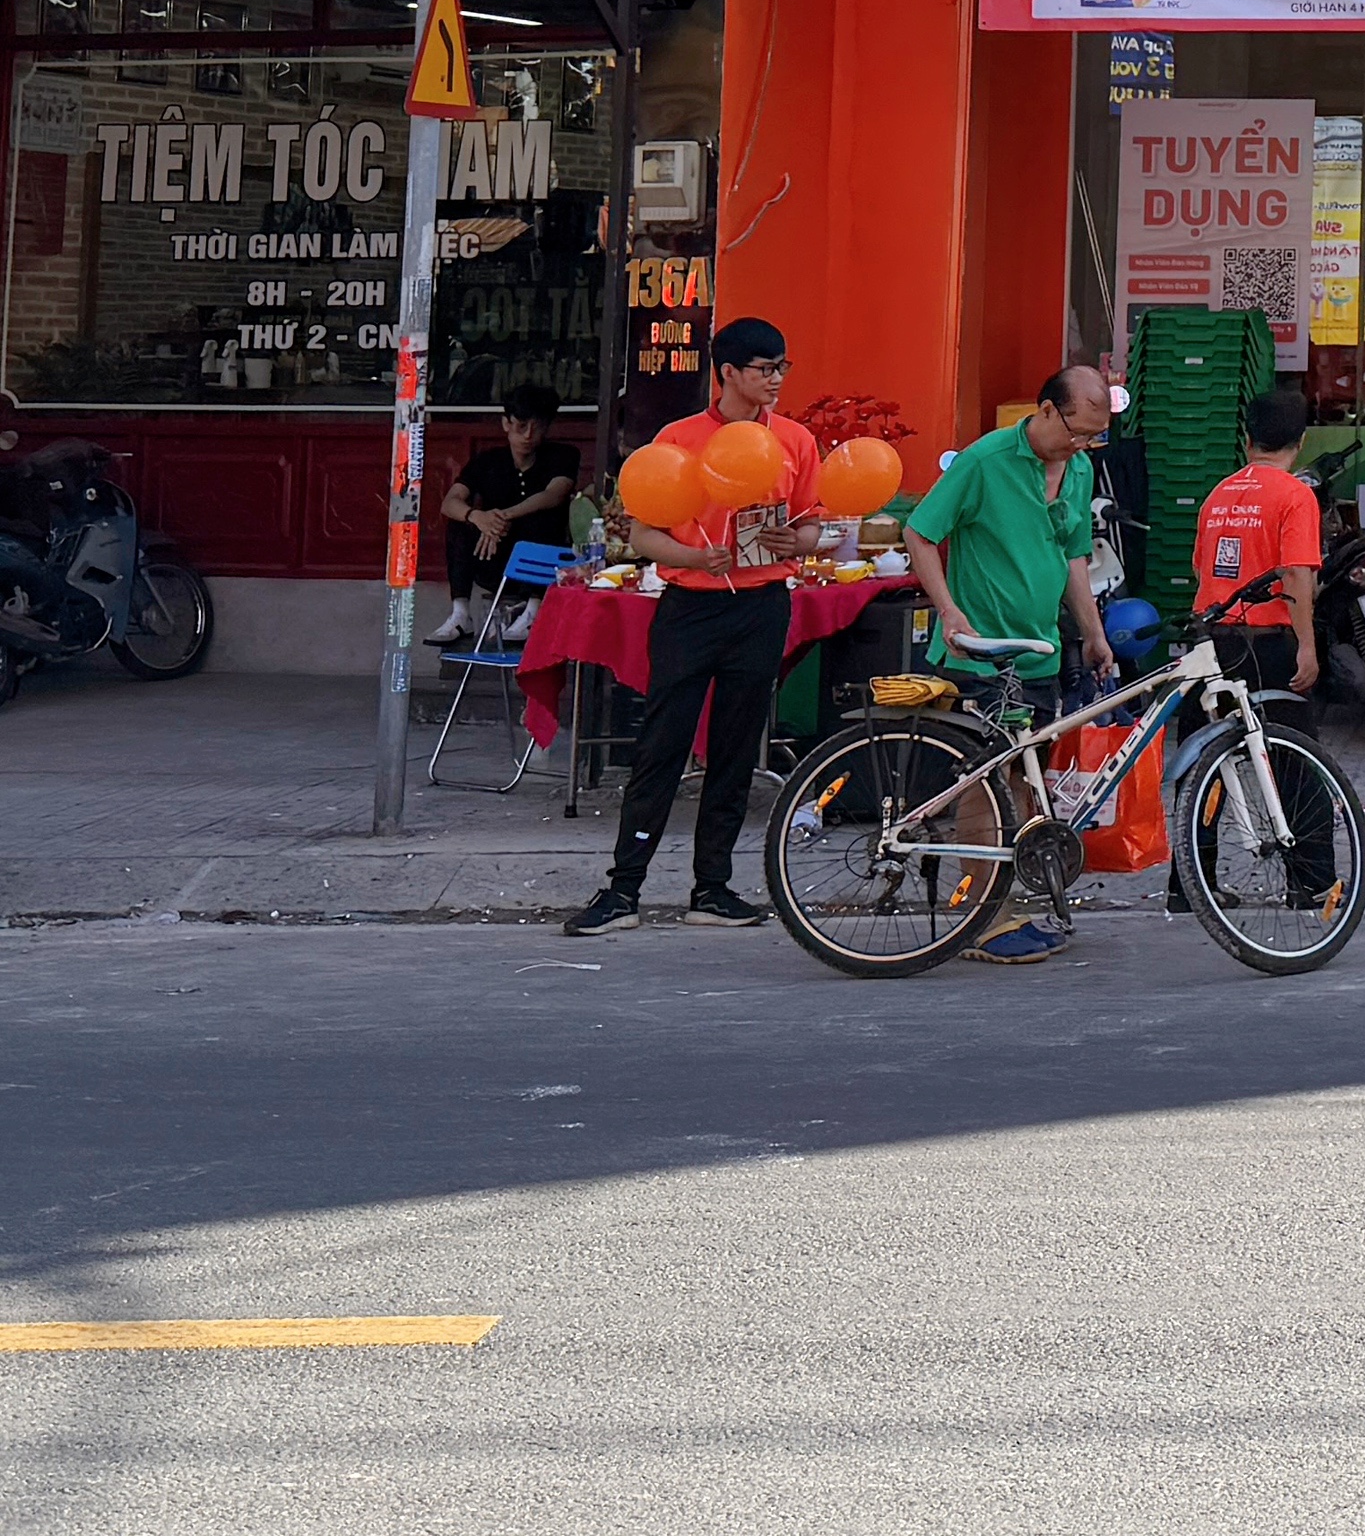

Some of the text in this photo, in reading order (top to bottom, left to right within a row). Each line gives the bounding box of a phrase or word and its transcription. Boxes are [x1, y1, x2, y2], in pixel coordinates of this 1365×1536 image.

[97, 105, 244, 222] TIỆM
[267, 105, 387, 201] TÓC
[1132, 119, 1299, 174] TUYỂN
[1144, 189, 1287, 237] DỤNG
[247, 281, 386, 306] 8H 20H
[626, 257, 711, 307] 136A
[239, 323, 400, 350] THỨ 2 CN
